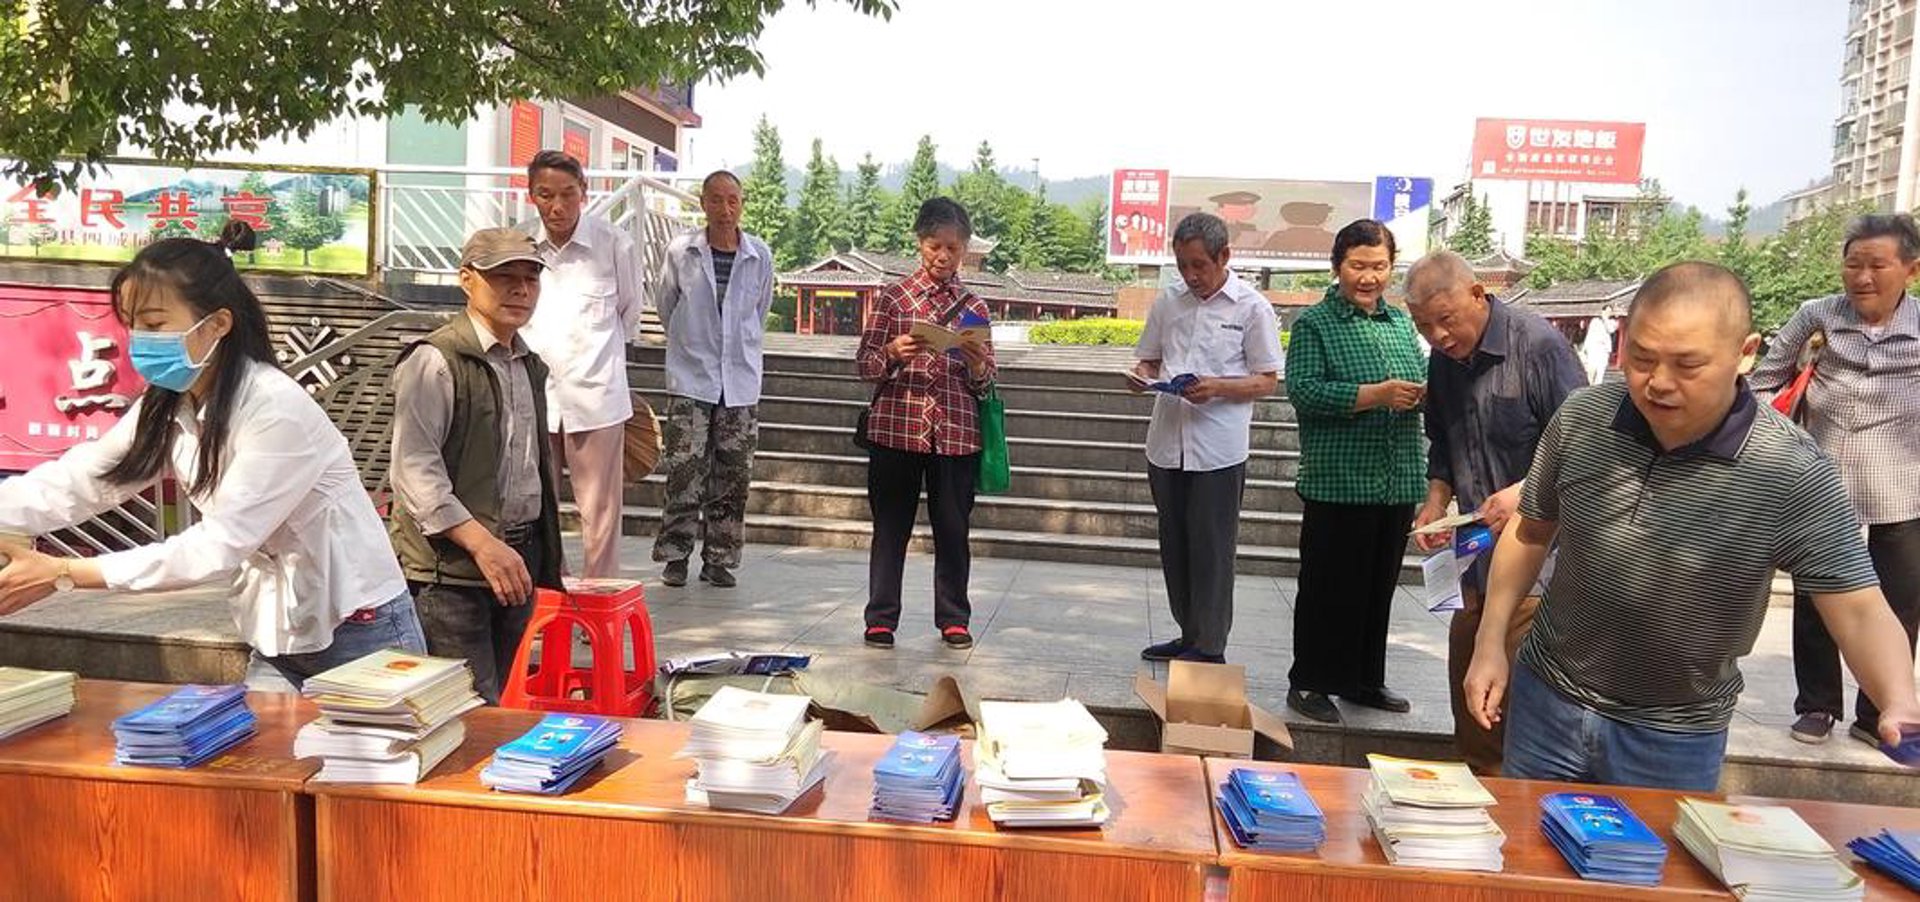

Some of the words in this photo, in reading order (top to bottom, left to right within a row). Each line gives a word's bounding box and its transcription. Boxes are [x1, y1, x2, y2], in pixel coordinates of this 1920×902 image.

[1530, 127, 1617, 149] 世友地板
[6, 183, 278, 232] 全民共享
[54, 331, 132, 414] 点
